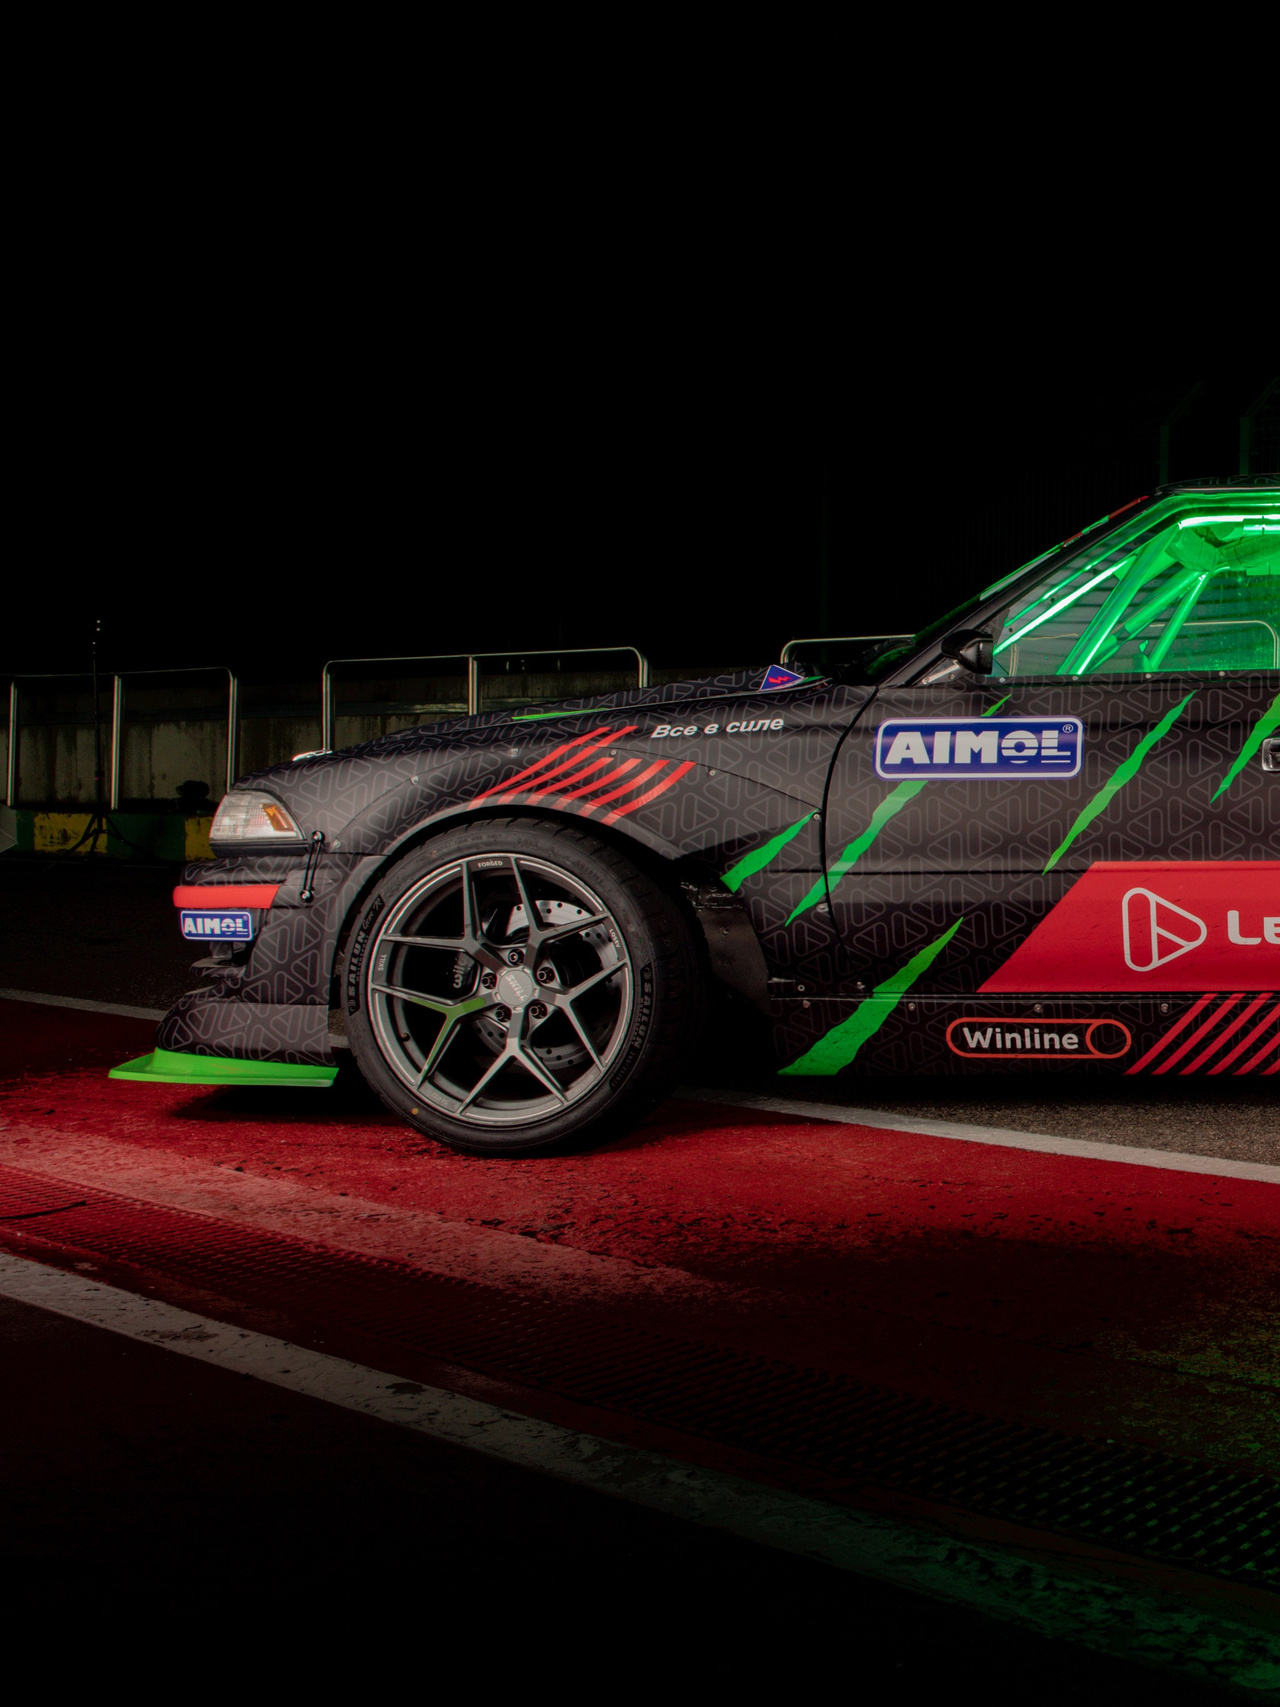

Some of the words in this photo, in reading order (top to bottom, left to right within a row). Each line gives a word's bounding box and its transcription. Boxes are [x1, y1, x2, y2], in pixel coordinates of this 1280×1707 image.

[651, 724, 698, 739] Все
[703, 723, 720, 735] в
[726, 717, 785, 734] силе
[478, 859, 503, 869] FORGED
[609, 928, 621, 949] LOSEV
[347, 930, 369, 997] SAILUN
[378, 953, 387, 972] SKILL
[636, 981, 652, 1050] SAILUN
[962, 1026, 1080, 1050] Winline
